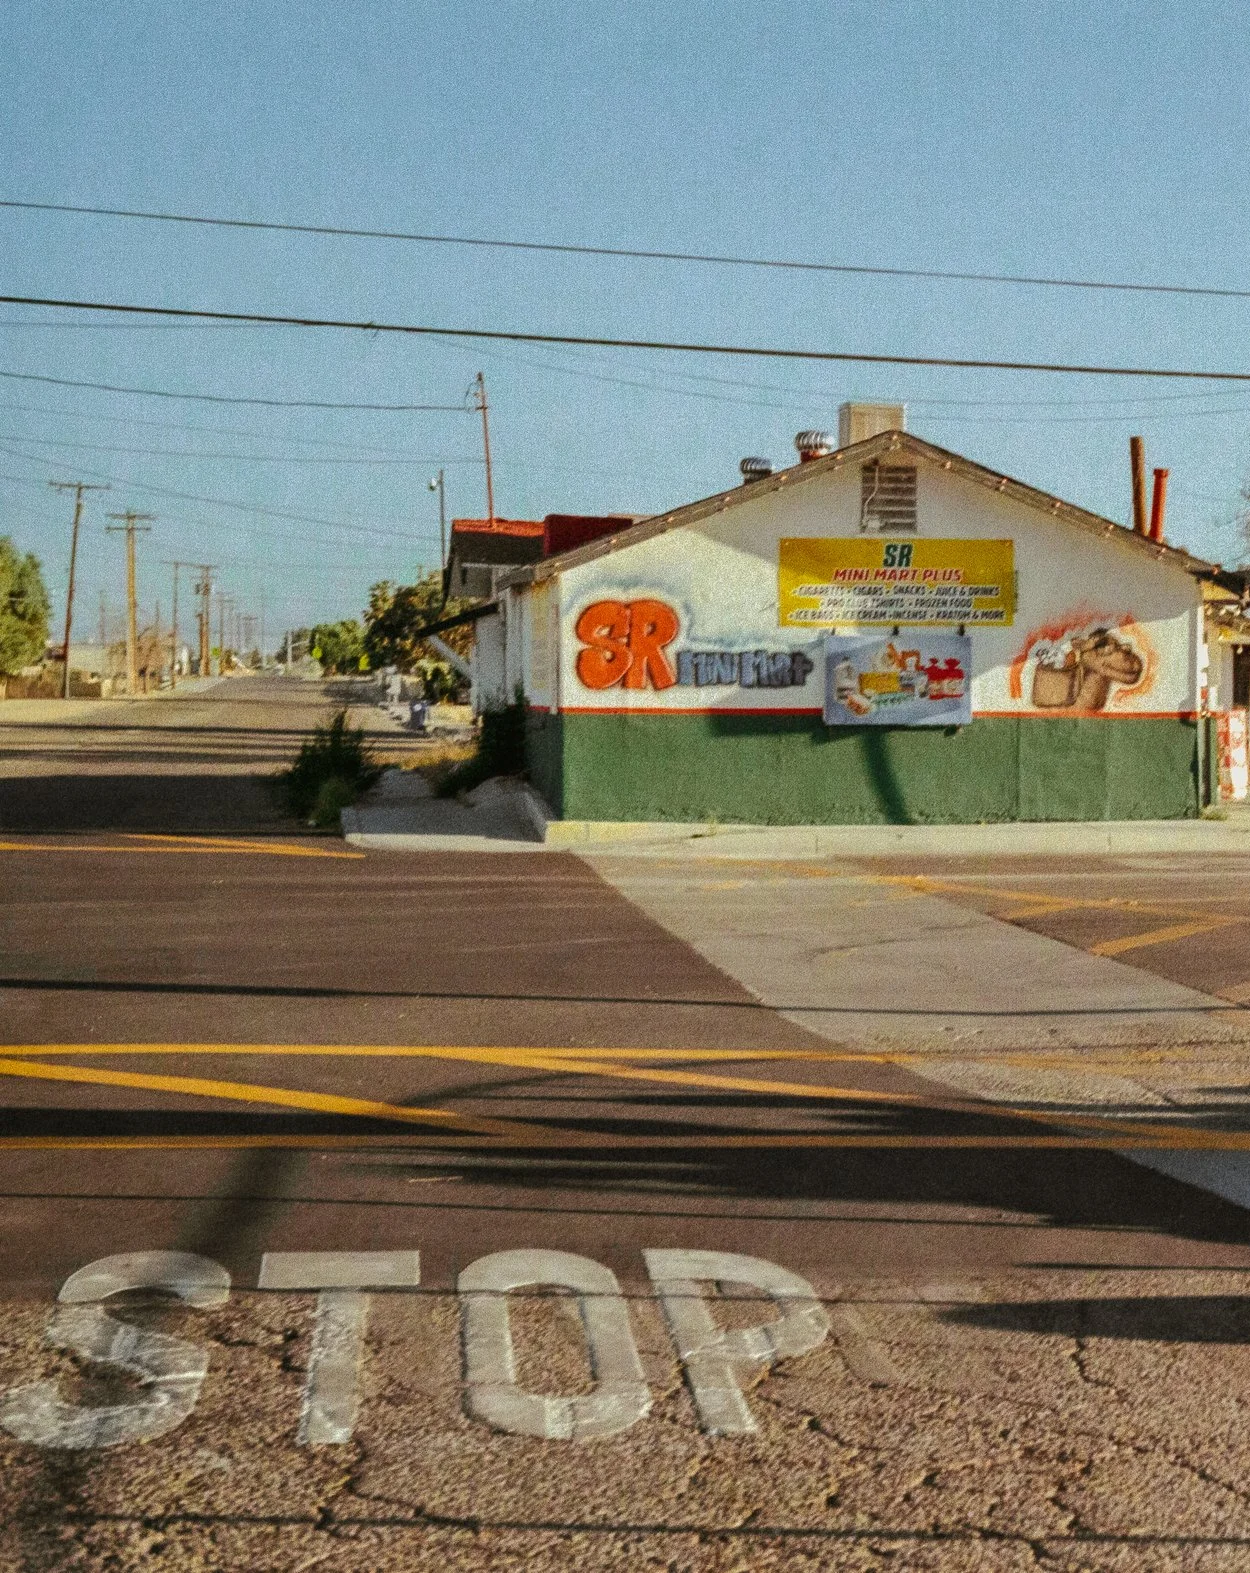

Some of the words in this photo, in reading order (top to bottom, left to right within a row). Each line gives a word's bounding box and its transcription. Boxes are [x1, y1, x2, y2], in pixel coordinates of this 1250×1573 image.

[882, 543, 913, 568] SR
[833, 569, 869, 582] MINI
[875, 569, 918, 582] MART
[923, 569, 962, 582] PLUS
[853, 586, 884, 596] CIGARS
[893, 586, 926, 596] SNACKS
[968, 586, 1000, 596] DRINKS
[915, 598, 948, 608] FROZEN
[950, 598, 972, 608] FOOD
[857, 610, 887, 620] CREAM
[981, 610, 1005, 620] MORE
[575, 598, 680, 691] SR
[0, 1248, 832, 1450] STOP
